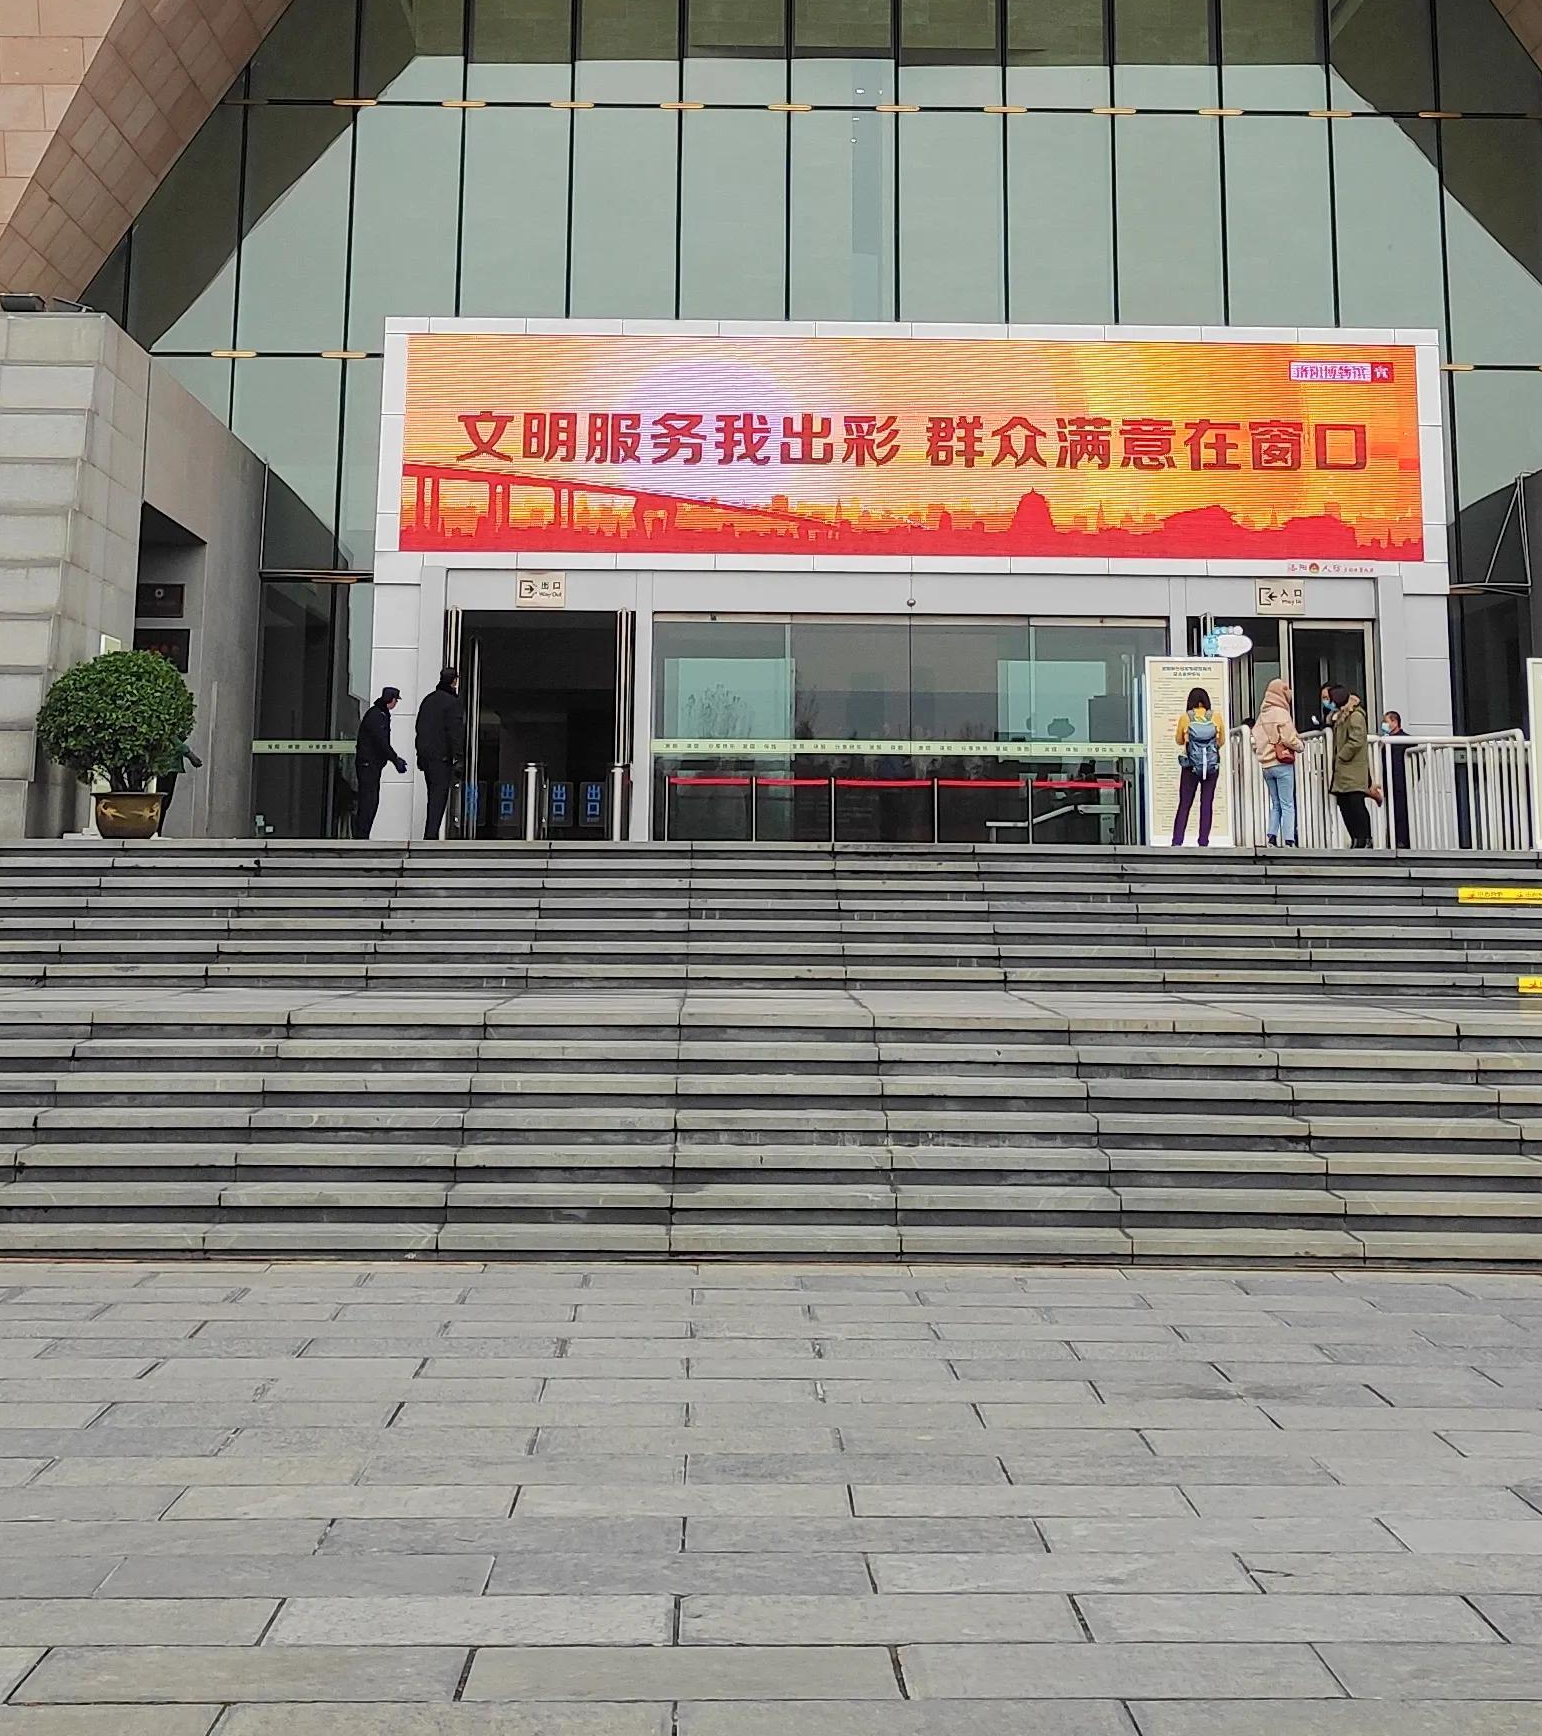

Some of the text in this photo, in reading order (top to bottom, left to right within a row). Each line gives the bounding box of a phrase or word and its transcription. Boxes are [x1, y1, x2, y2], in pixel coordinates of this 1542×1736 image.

[457, 410, 1371, 473] 文明服务我出彩 群众满意在窗口
[541, 581, 561, 590] 出口
[1280, 589, 1302, 597] 入口
[500, 783, 515, 815] 出口
[552, 784, 566, 815] 出口
[586, 784, 601, 816] 出口
